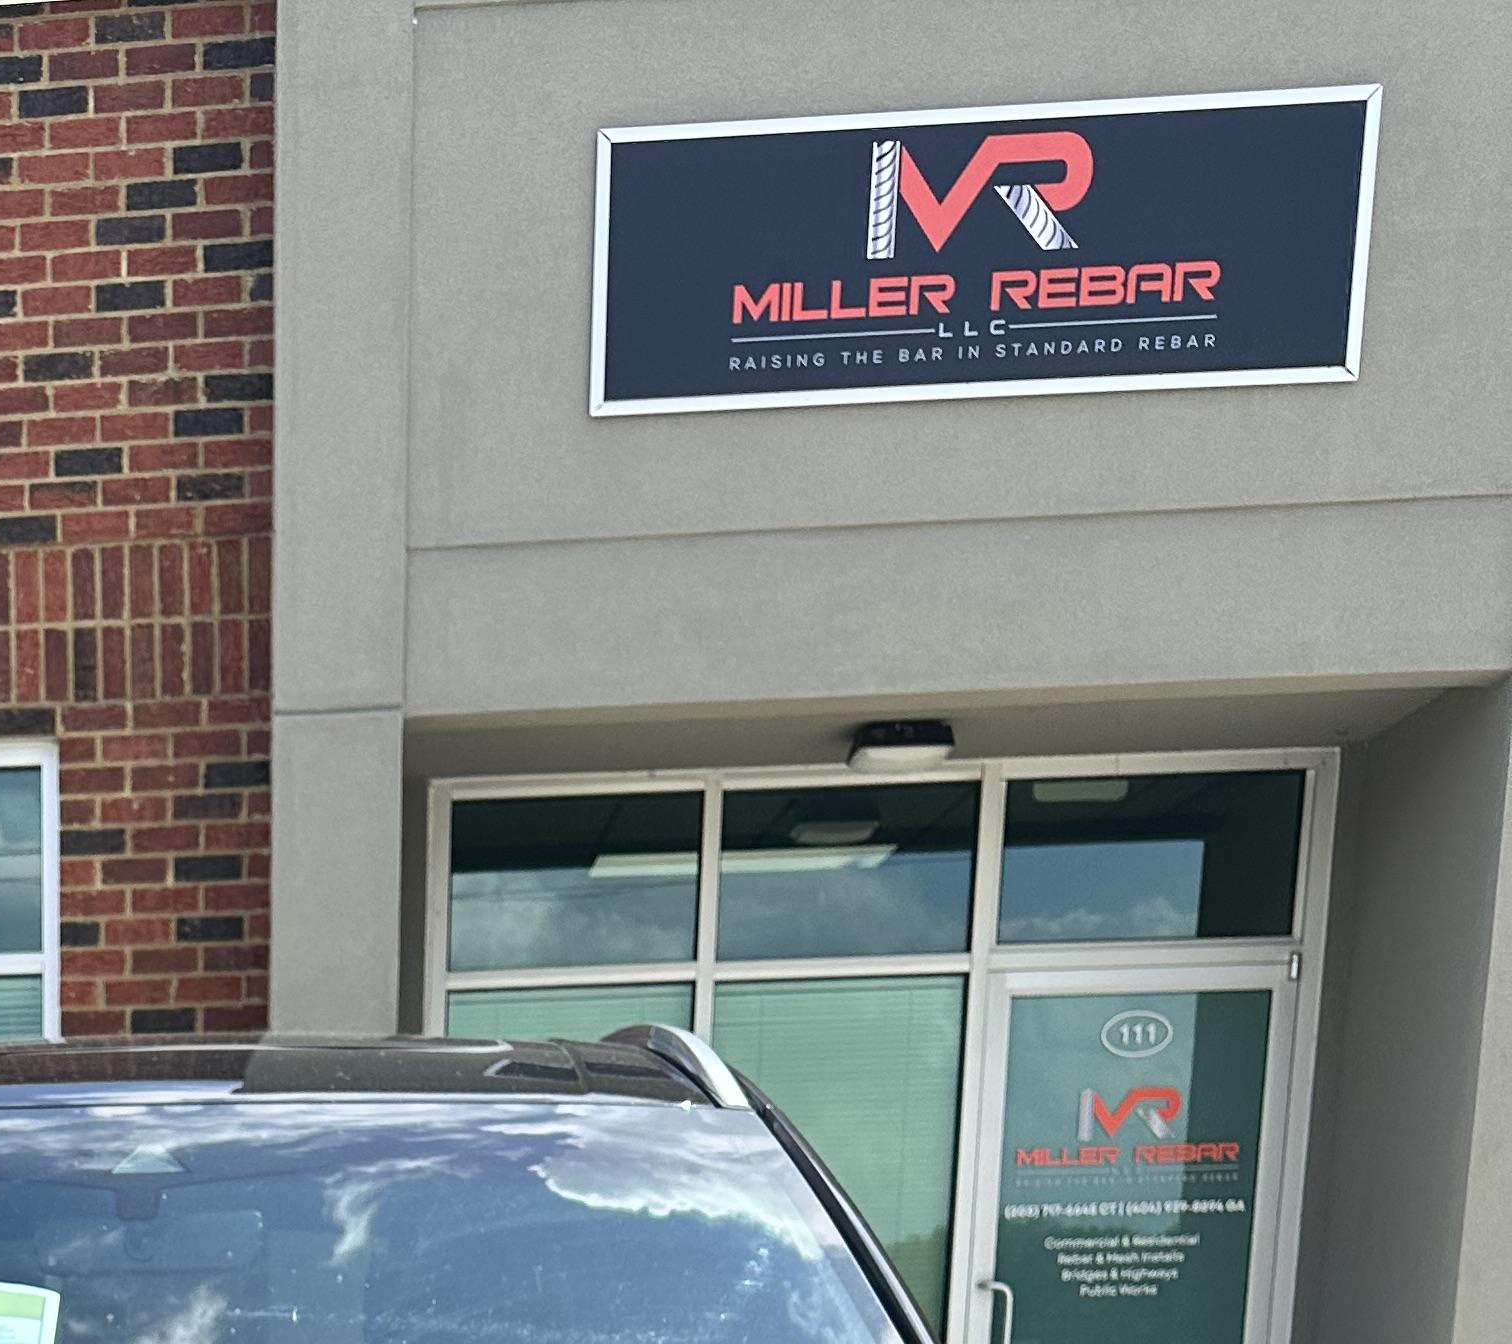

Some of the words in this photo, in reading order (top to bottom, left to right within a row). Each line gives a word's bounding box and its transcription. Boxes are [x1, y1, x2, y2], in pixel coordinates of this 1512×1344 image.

[732, 273, 956, 324] MILLER
[989, 260, 1222, 312] REBAR
[938, 319, 1006, 338] LLC
[728, 352, 826, 371] RAISING
[840, 349, 884, 366] THE
[898, 346, 944, 363] BAR
[958, 345, 980, 360] IN
[994, 338, 1123, 358] STANDARD
[1138, 333, 1217, 351] REBAR
[1119, 1022, 1157, 1045] 111
[1016, 1145, 1119, 1167] MILLER
[1133, 1142, 1240, 1164] REBAR
